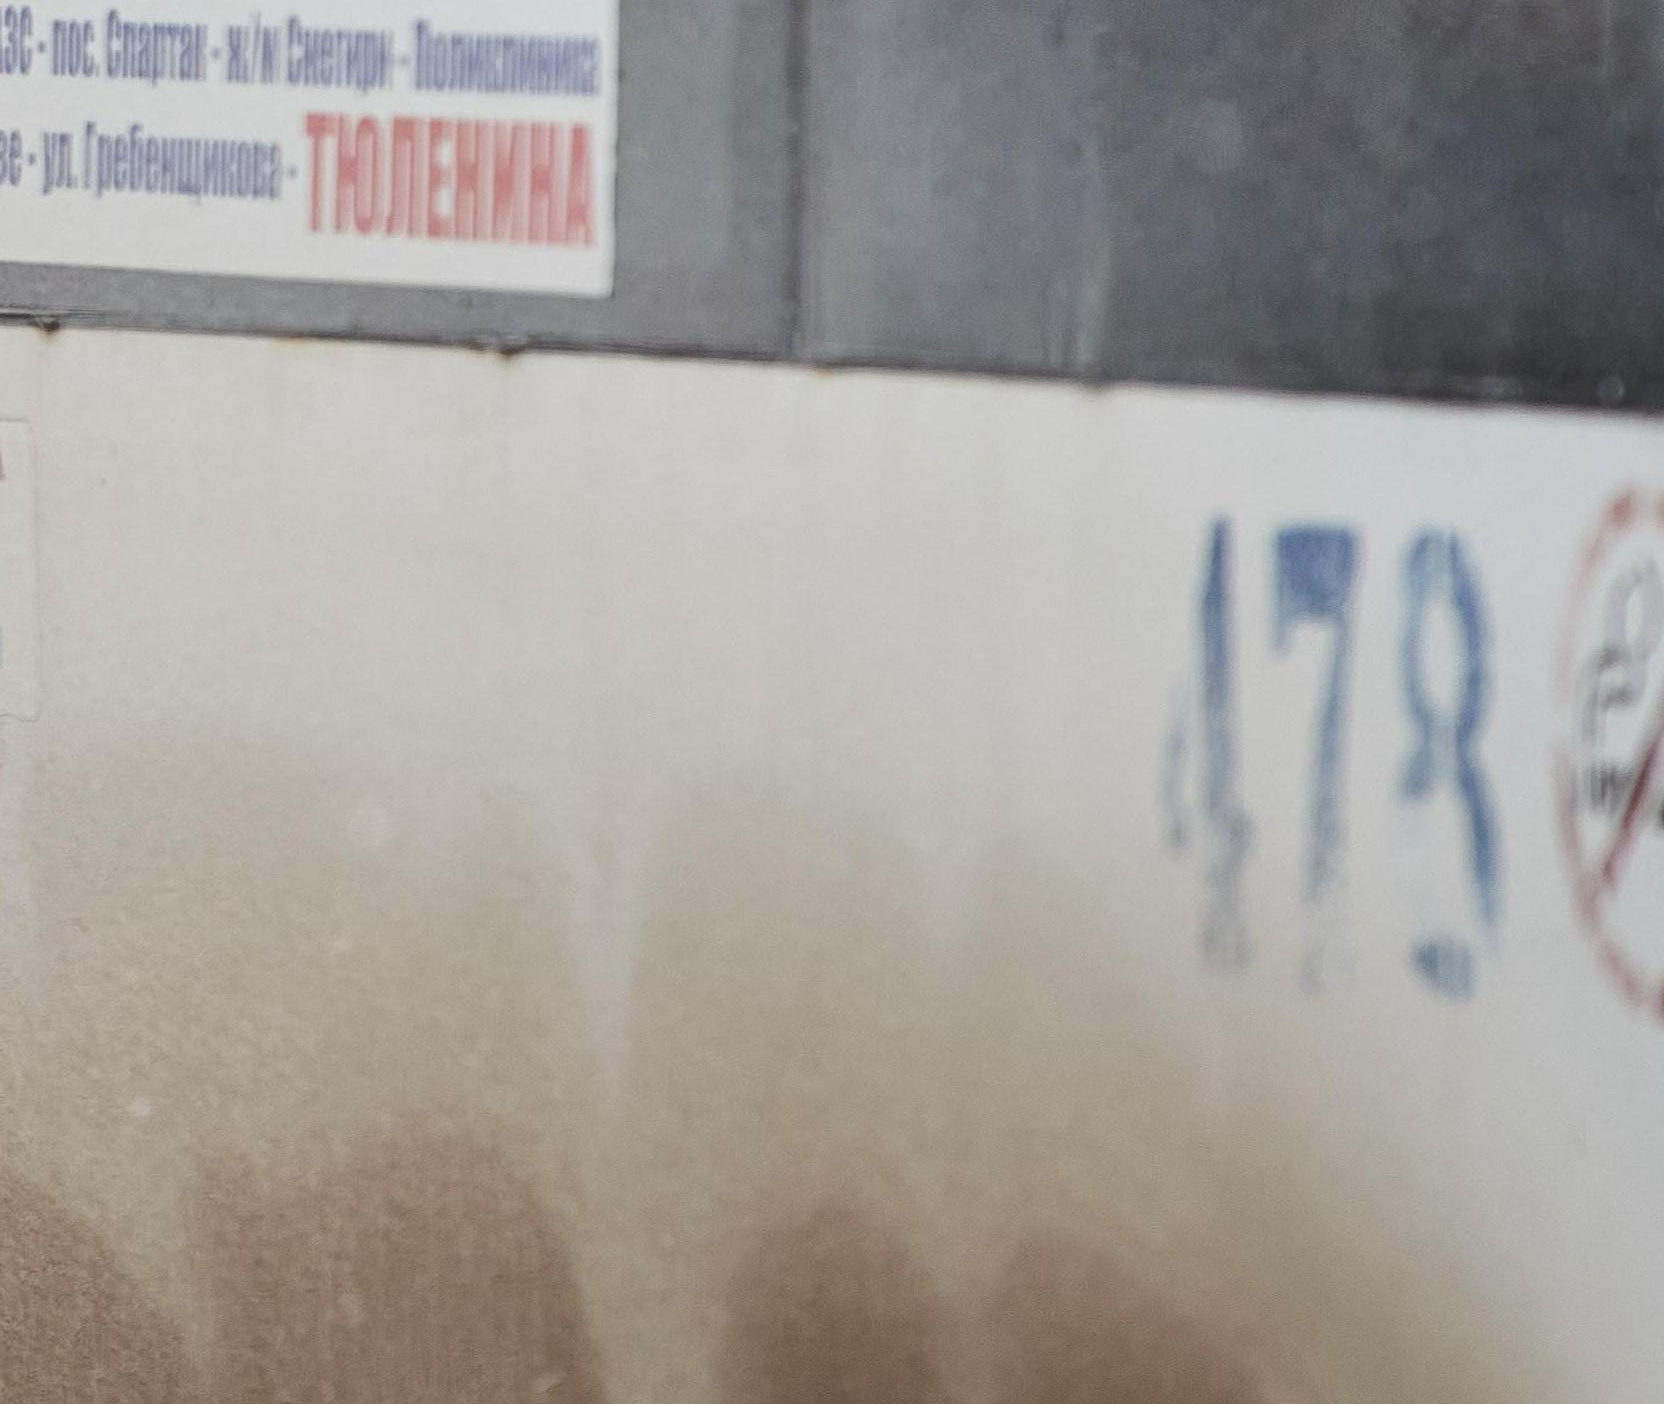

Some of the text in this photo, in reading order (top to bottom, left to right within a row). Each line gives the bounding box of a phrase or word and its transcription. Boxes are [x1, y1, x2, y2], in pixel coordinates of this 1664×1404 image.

[51, 19, 99, 77] пос.
[105, 8, 207, 86] Спартак
[40, 131, 79, 197] ул.
[302, 111, 598, 244] ТЮЛЕНИНА
